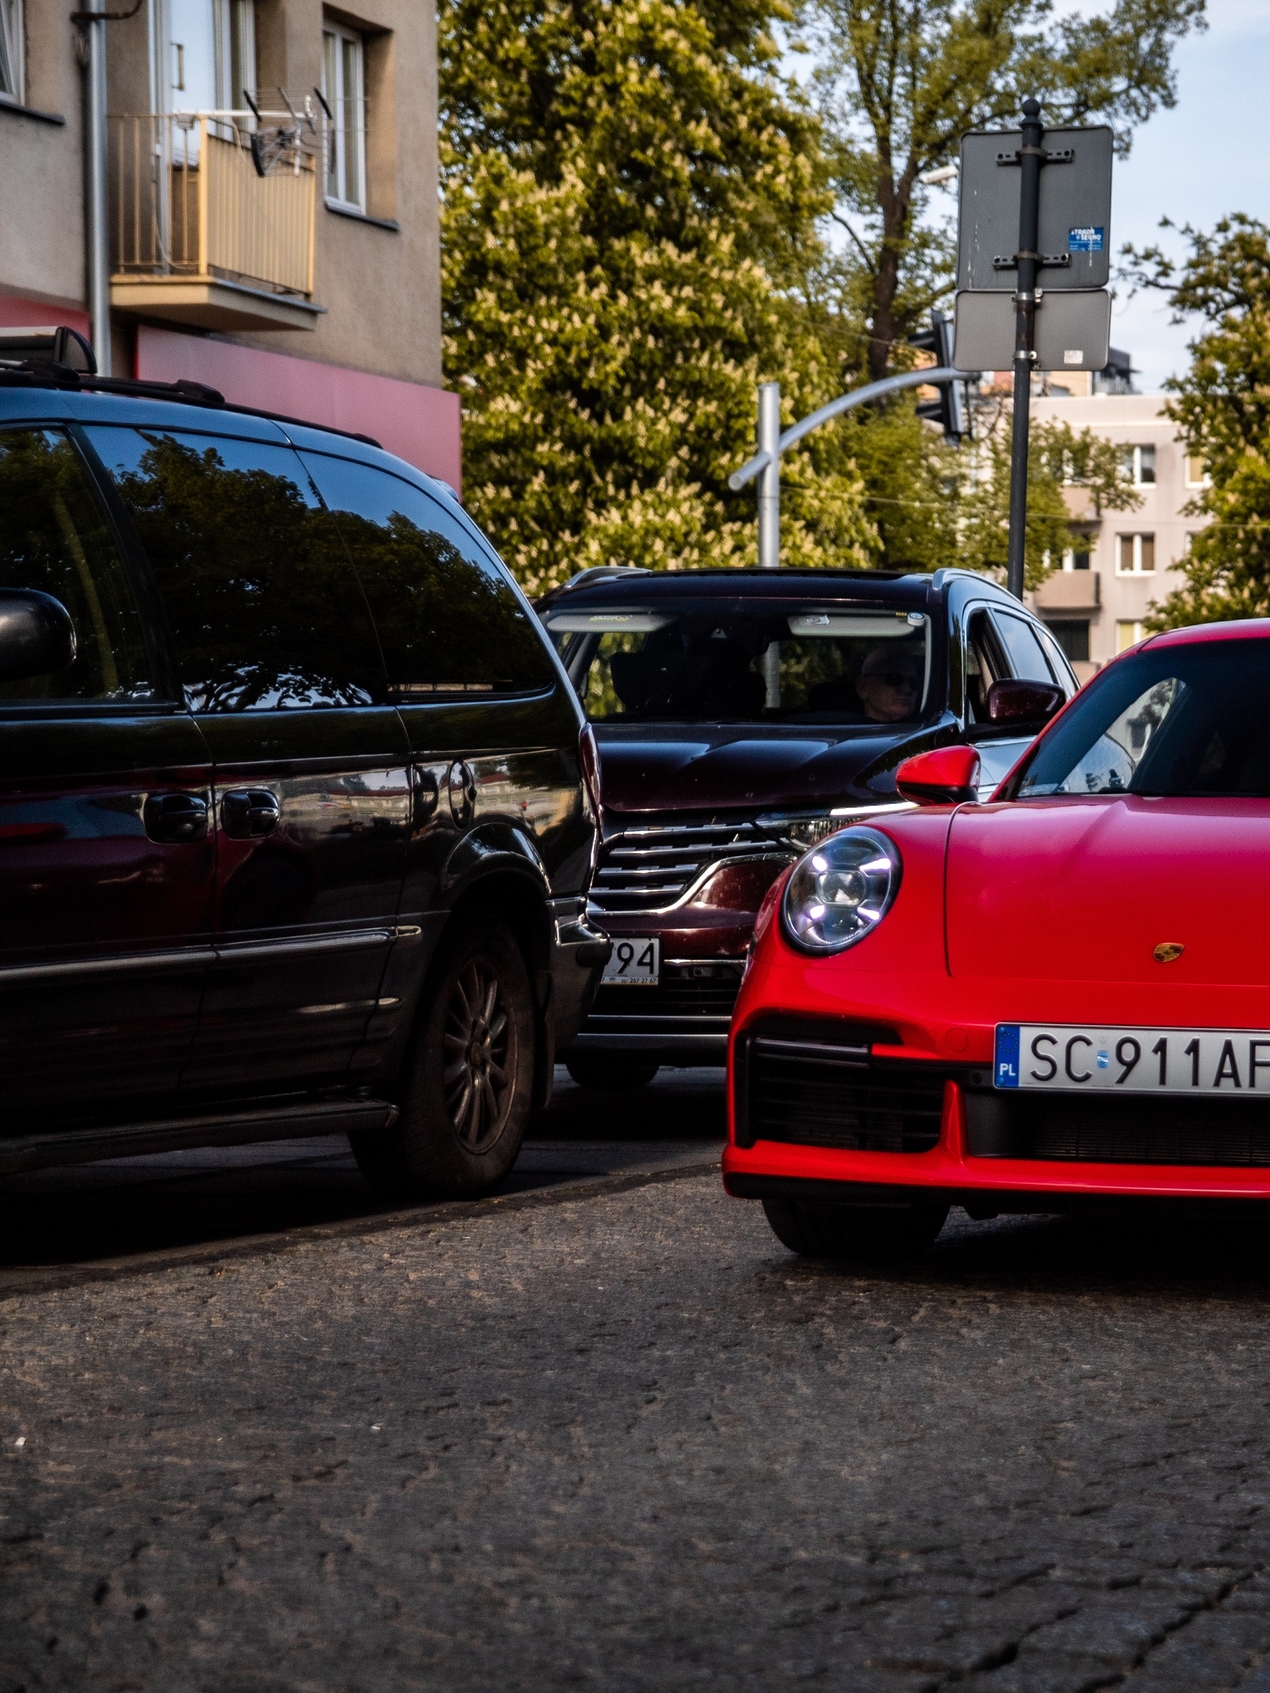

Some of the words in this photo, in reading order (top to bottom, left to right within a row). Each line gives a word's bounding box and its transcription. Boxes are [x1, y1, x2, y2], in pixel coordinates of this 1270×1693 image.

[609, 942, 655, 974] 94
[1000, 1063, 1016, 1076] PL
[1030, 1033, 1093, 1082] SC
